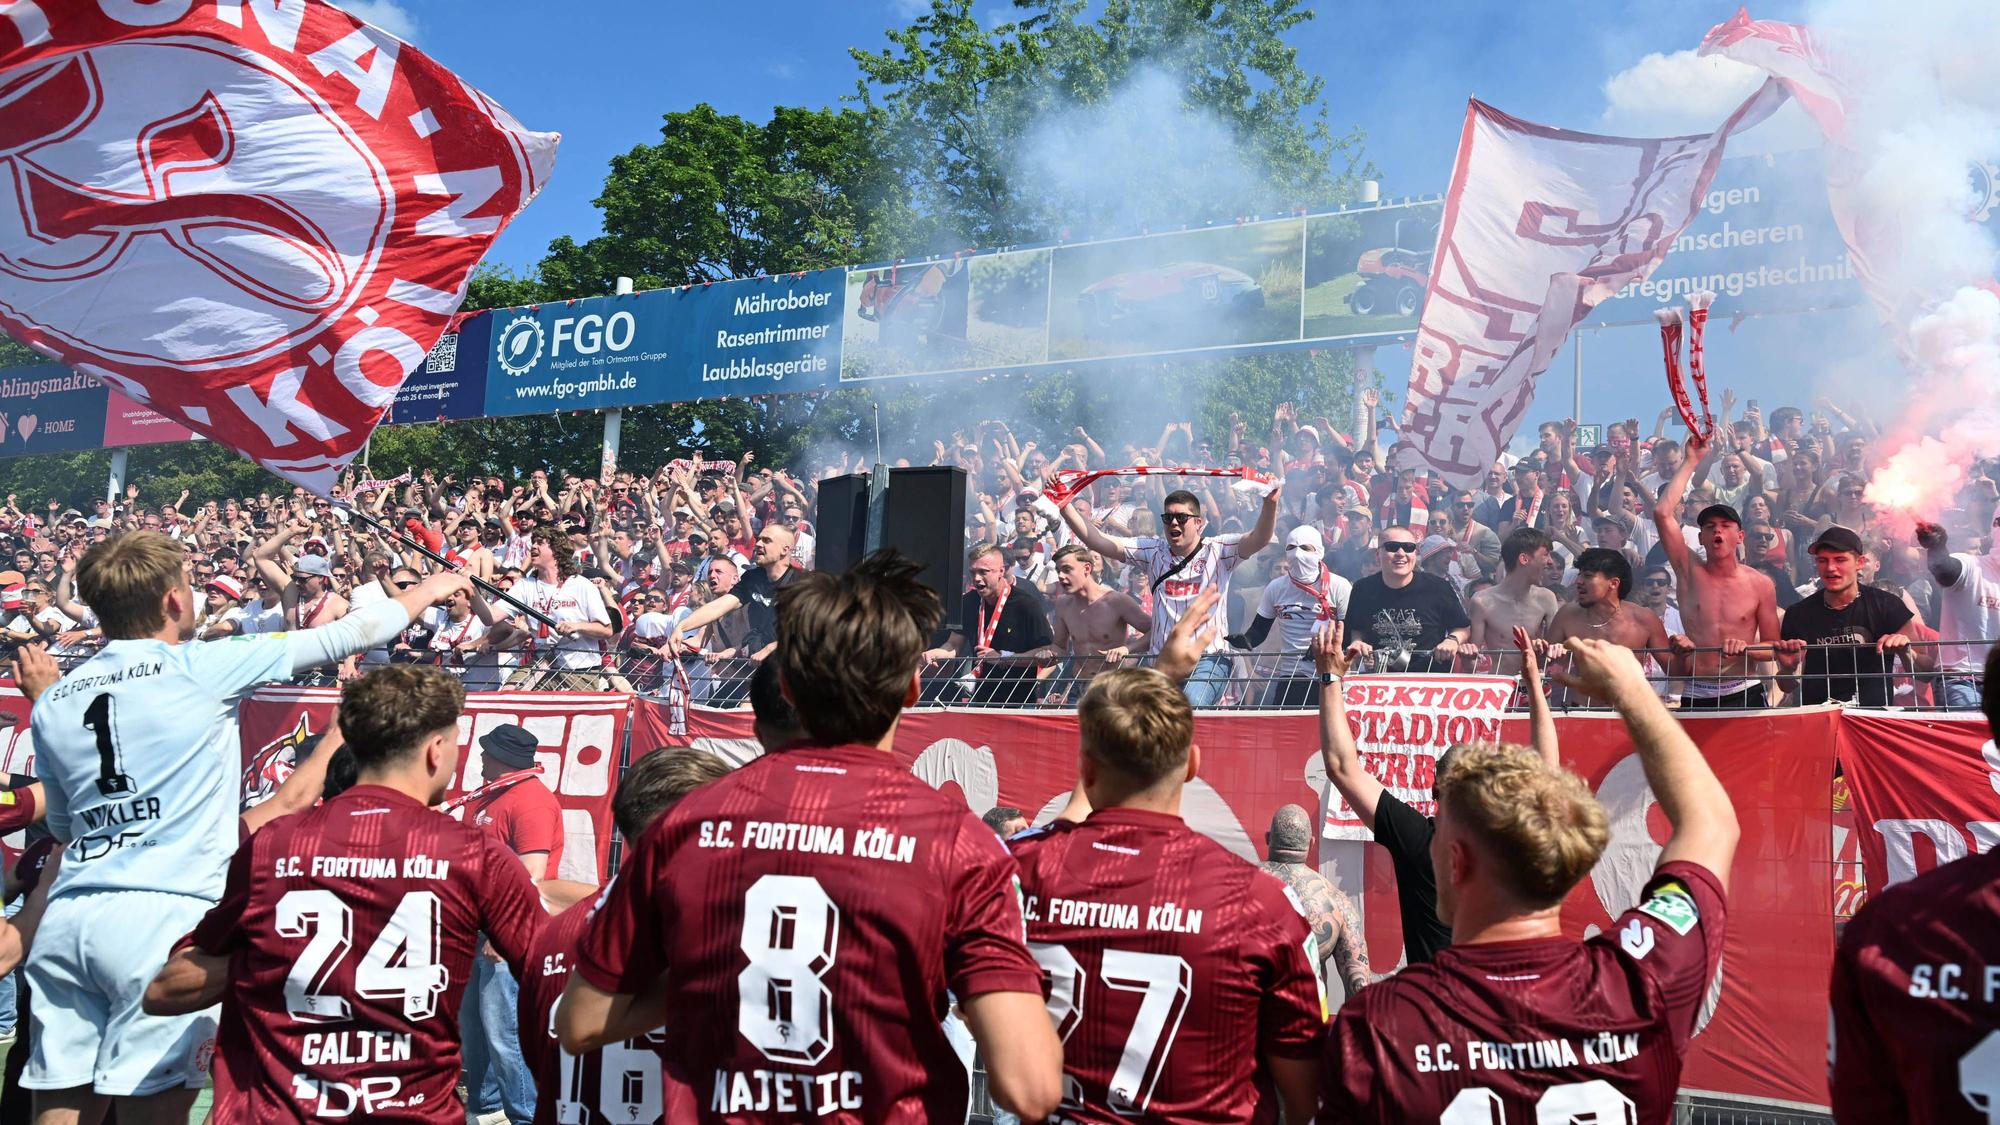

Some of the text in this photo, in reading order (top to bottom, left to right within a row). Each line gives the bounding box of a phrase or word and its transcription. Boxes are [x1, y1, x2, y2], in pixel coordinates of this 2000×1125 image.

[1667, 222, 1804, 254] enscheren
[1614, 253, 1859, 302] eregnungstechnik
[734, 289, 832, 316] Mähroboter
[551, 311, 636, 357] FGO
[717, 323, 830, 348] Rasentrimmer
[550, 351, 667, 371] Mitglied der Tom Ortmanns Gruppe
[702, 353, 827, 381] Laubblasgeräte
[0, 371, 101, 399] blingsmakle
[410, 383, 428, 393] digital
[515, 371, 637, 399] www.fgo-gmbh.de
[44, 419, 75, 434] HOME
[1816, 633, 1854, 646] NORTH
[71, 672, 123, 695] FORTUNA
[127, 661, 163, 679] KÖLN
[1345, 684, 1508, 711] SEKTION
[1345, 709, 1505, 747] STADION
[83, 692, 138, 799] 1
[698, 820, 917, 864] S.C. FORTUNA KÖLN
[275, 854, 450, 880] S.C. FORTUNA KÖLN
[1048, 898, 1139, 930] FORTUNA
[1146, 902, 1203, 934] KÖLN
[274, 889, 449, 1024] 24
[542, 952, 566, 976] S.C.
[738, 874, 840, 1067] 8
[1908, 963, 1969, 1000] S.C.
[301, 1030, 412, 1066] GALJEN
[1414, 1031, 1640, 1073] S.C. FORTUNA KÖLN
[408, 1092, 425, 1107] AG
